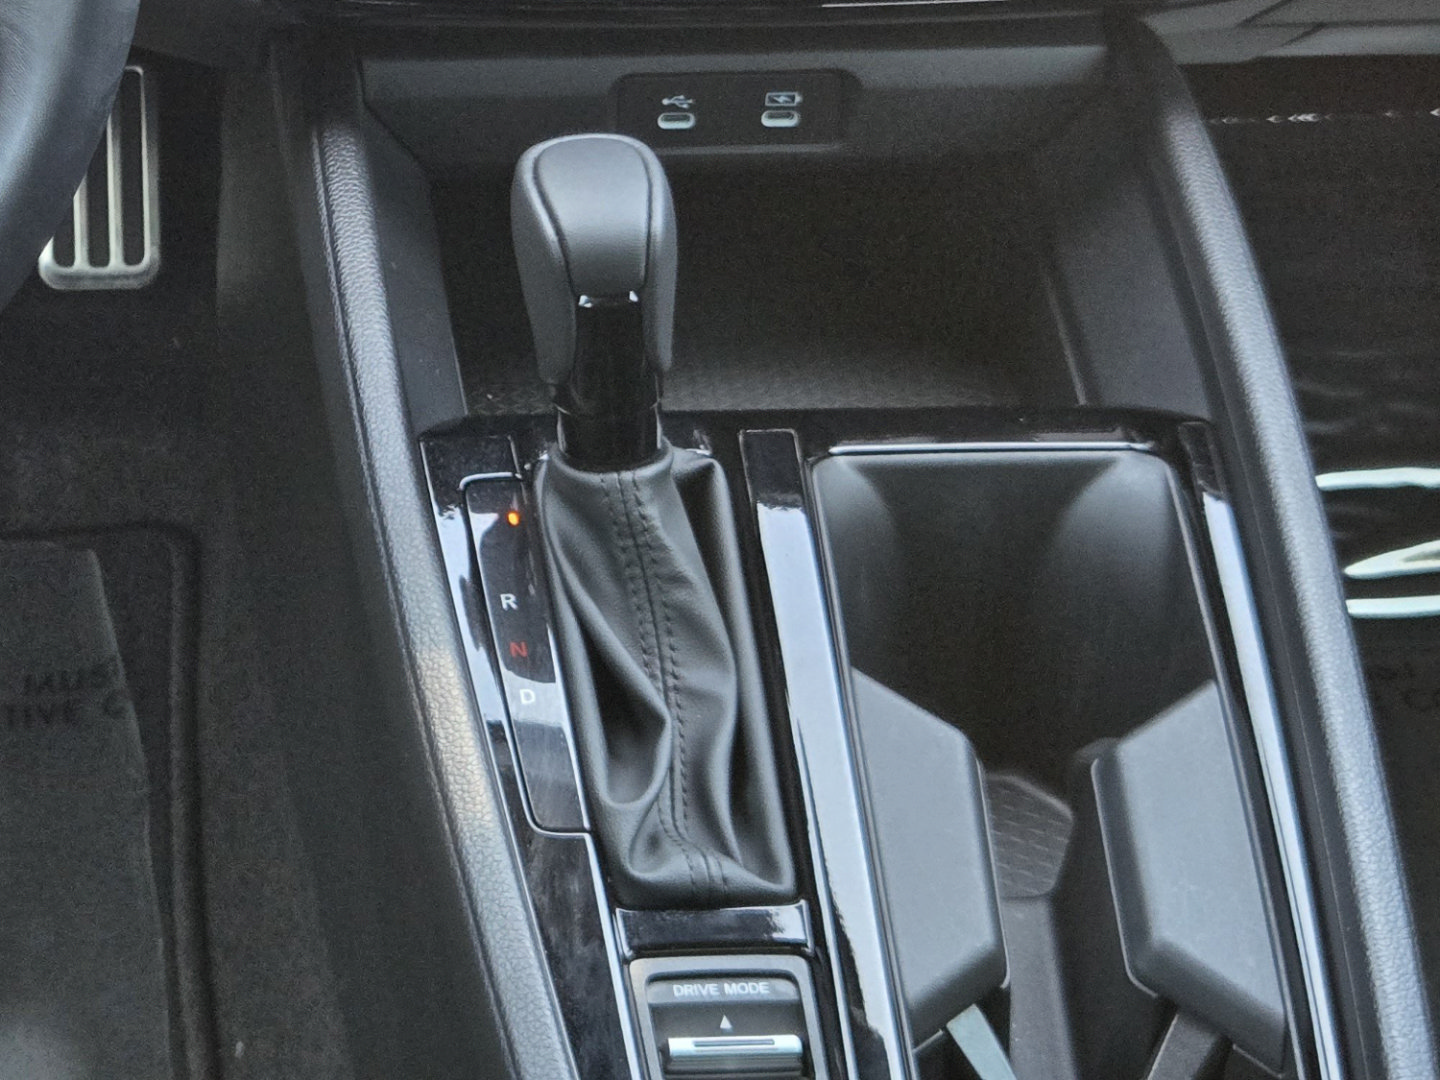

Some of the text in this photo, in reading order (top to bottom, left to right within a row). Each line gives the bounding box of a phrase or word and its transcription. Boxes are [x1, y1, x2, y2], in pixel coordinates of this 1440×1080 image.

[500, 593, 519, 611] R
[510, 641, 528, 657] N
[519, 688, 536, 705] D
[673, 981, 770, 997] DRIVE MODE
